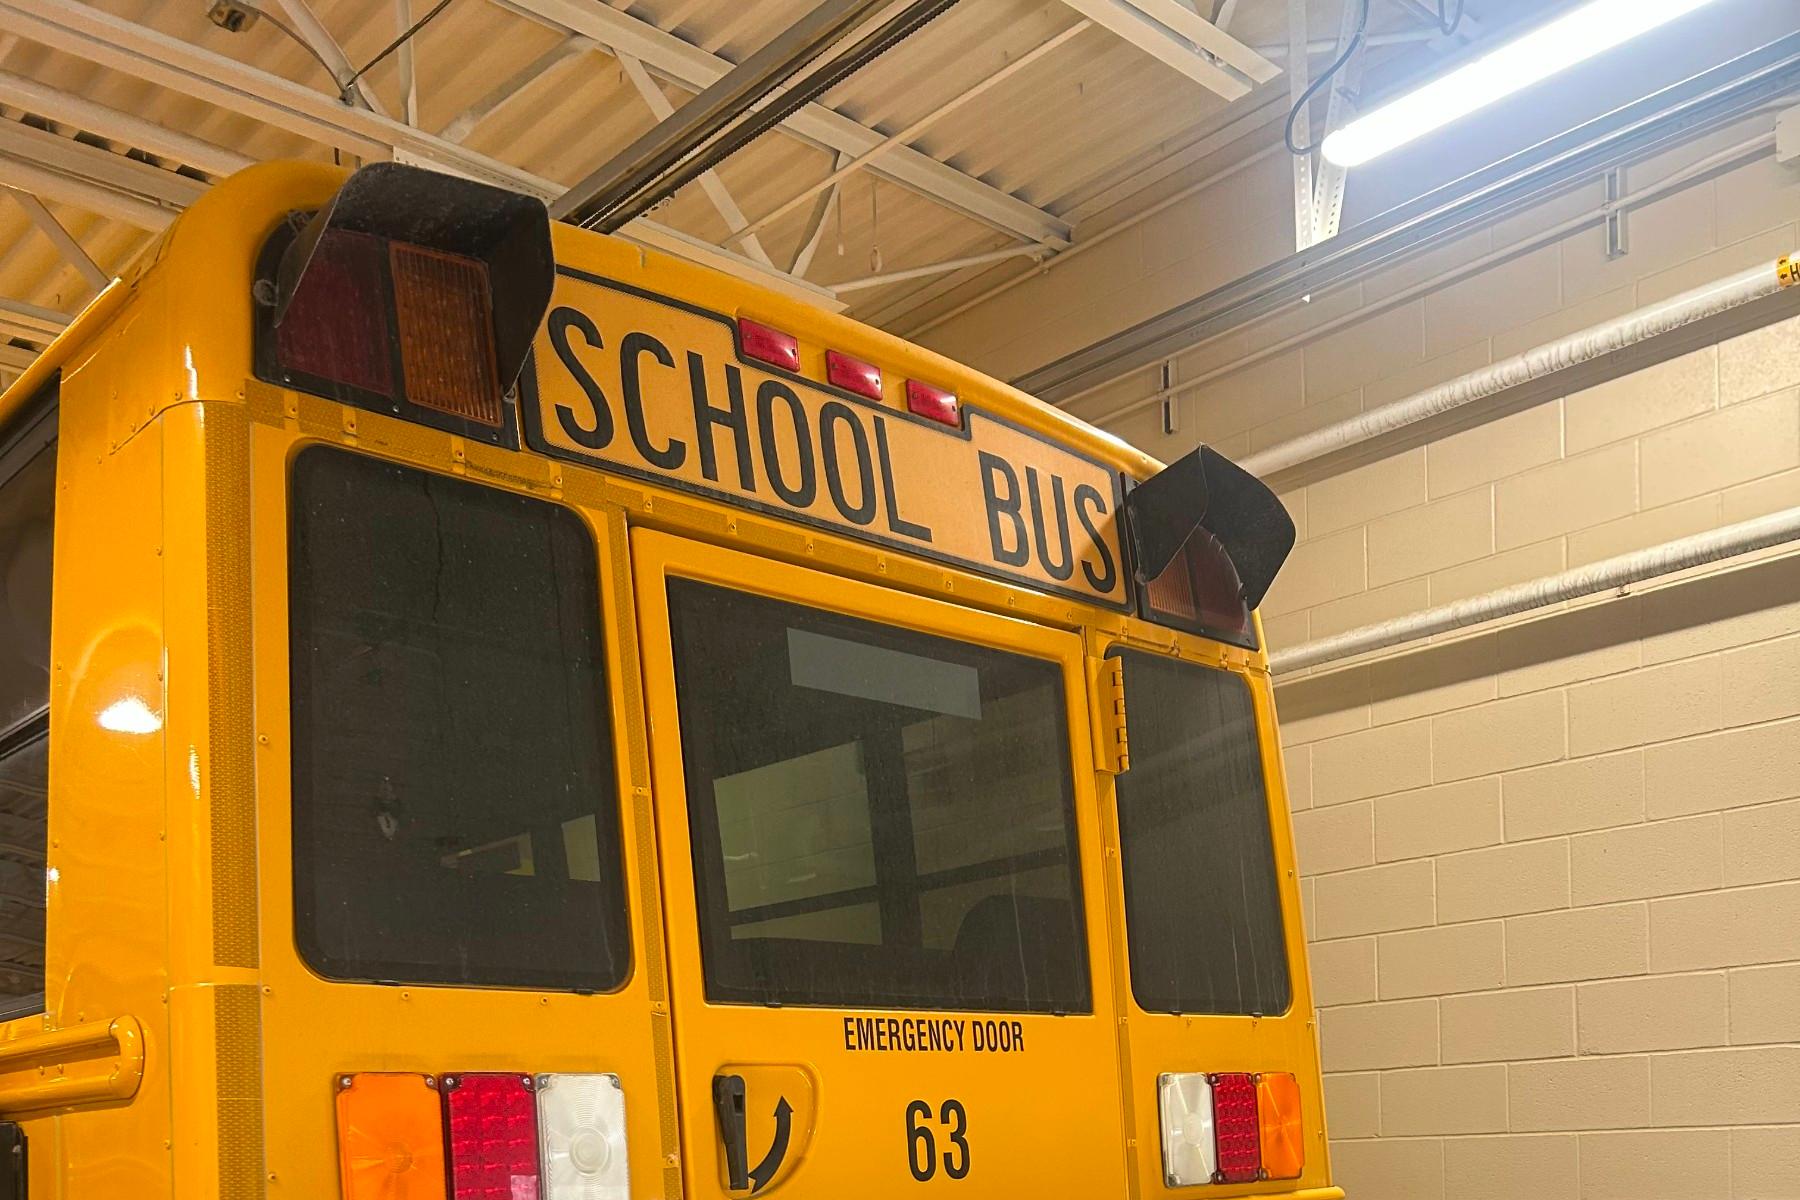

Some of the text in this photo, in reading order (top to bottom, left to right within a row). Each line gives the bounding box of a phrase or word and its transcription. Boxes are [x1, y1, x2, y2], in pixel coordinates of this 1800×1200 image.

[547, 306, 1117, 594] SCHOOL BUS
[843, 1017, 1024, 1052] EMERGENCY DOOR
[905, 1099, 971, 1182] 63
